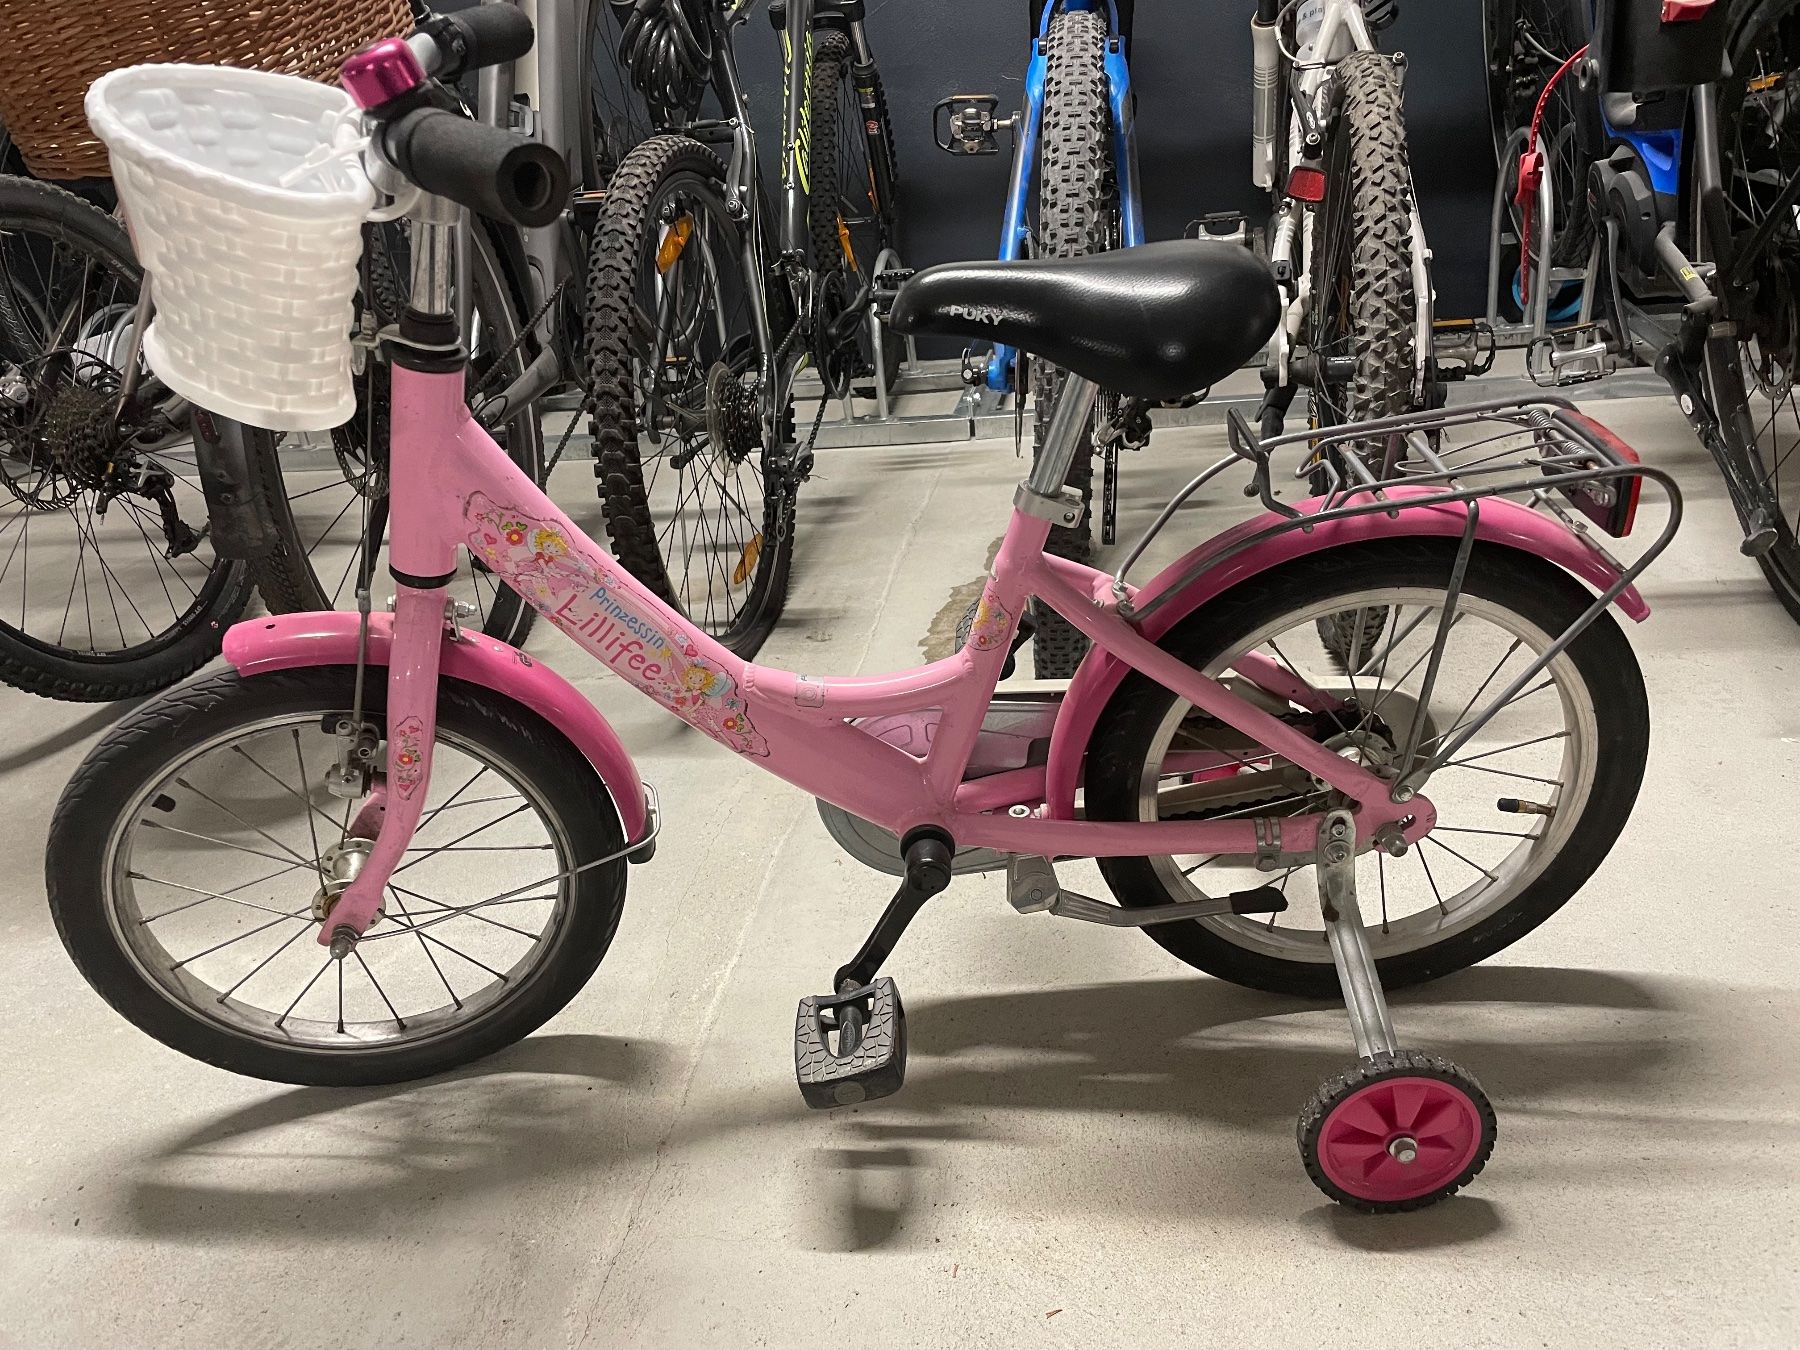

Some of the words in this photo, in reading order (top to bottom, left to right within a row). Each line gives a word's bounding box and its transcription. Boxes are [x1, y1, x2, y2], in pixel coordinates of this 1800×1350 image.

[1309, 7, 1323, 18] pla
[949, 304, 1004, 325] PUKY
[555, 593, 662, 681] Lillifee
[589, 586, 665, 650] Prinzessin
